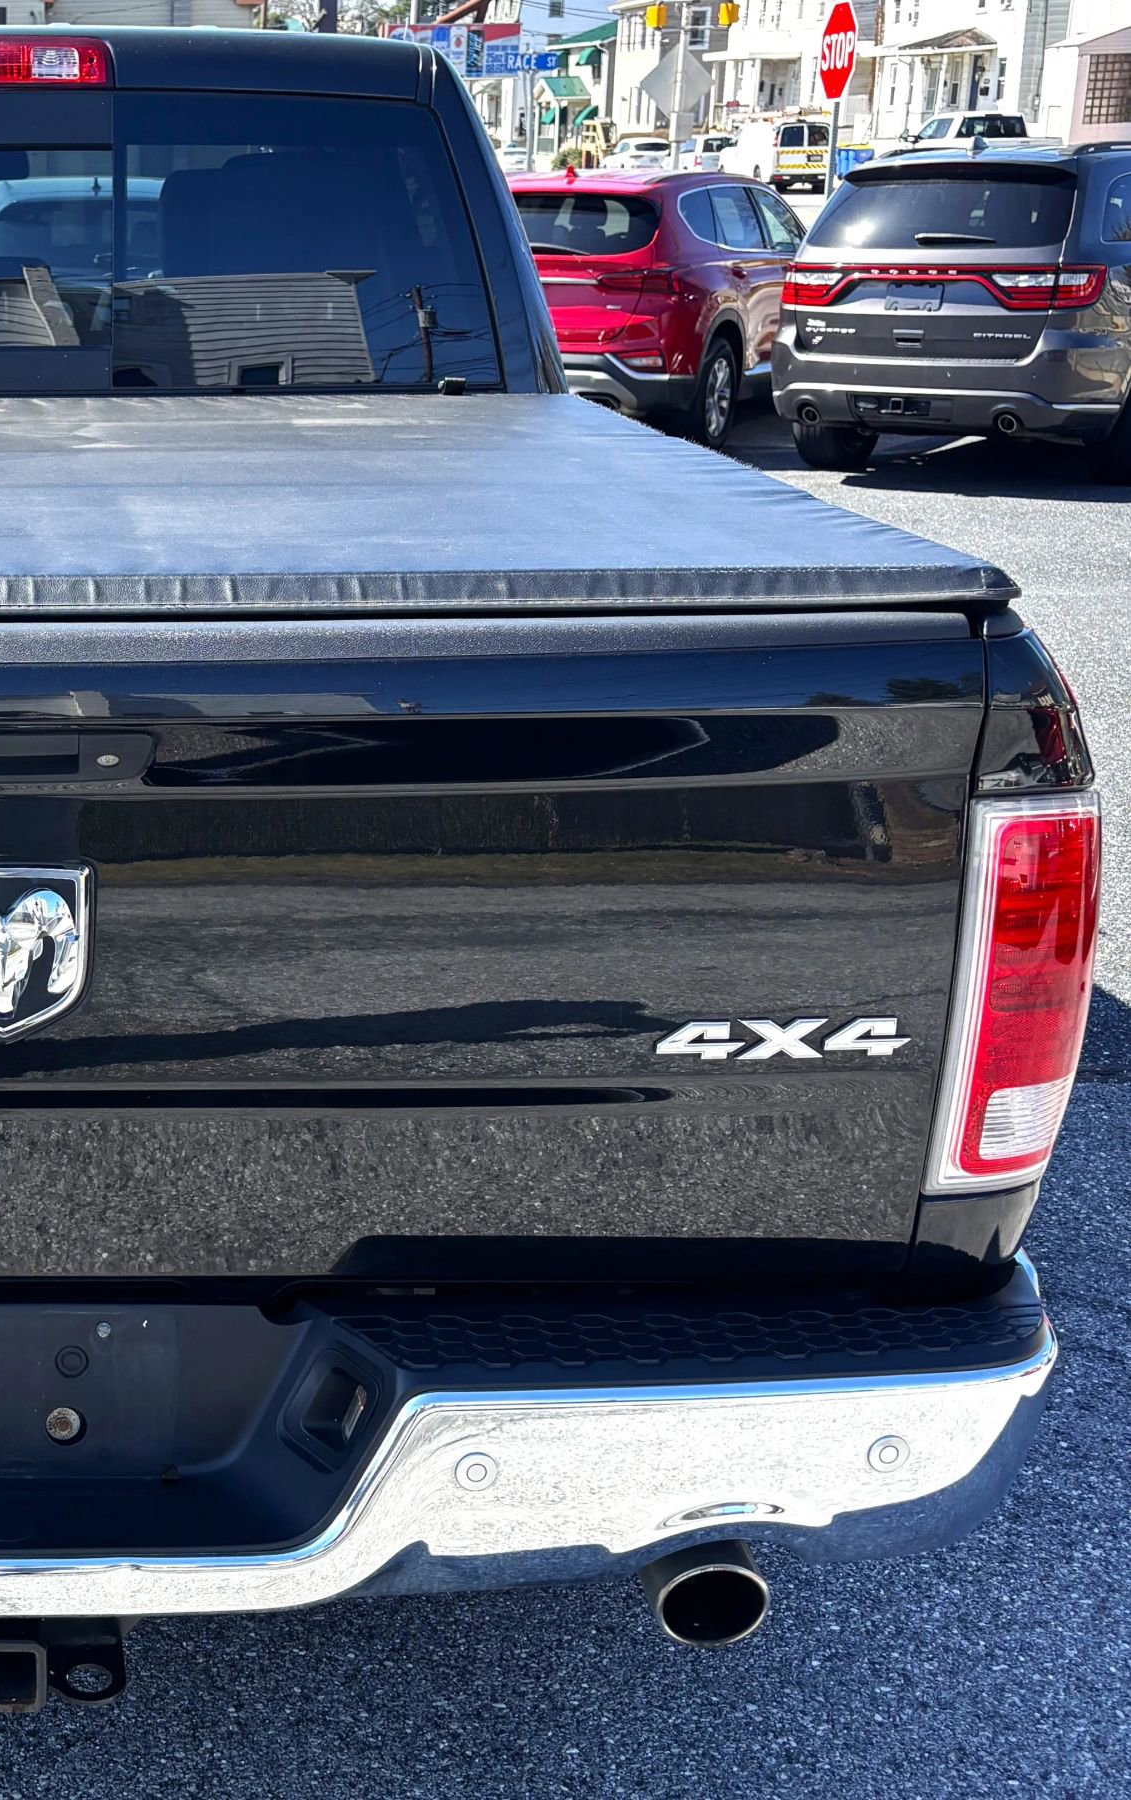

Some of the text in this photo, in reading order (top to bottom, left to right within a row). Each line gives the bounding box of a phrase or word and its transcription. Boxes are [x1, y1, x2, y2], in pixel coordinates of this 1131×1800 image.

[507, 54, 537, 70] RACE
[546, 57, 557, 67] ST
[821, 31, 855, 72] STOP
[655, 1017, 912, 1060] 4X4
